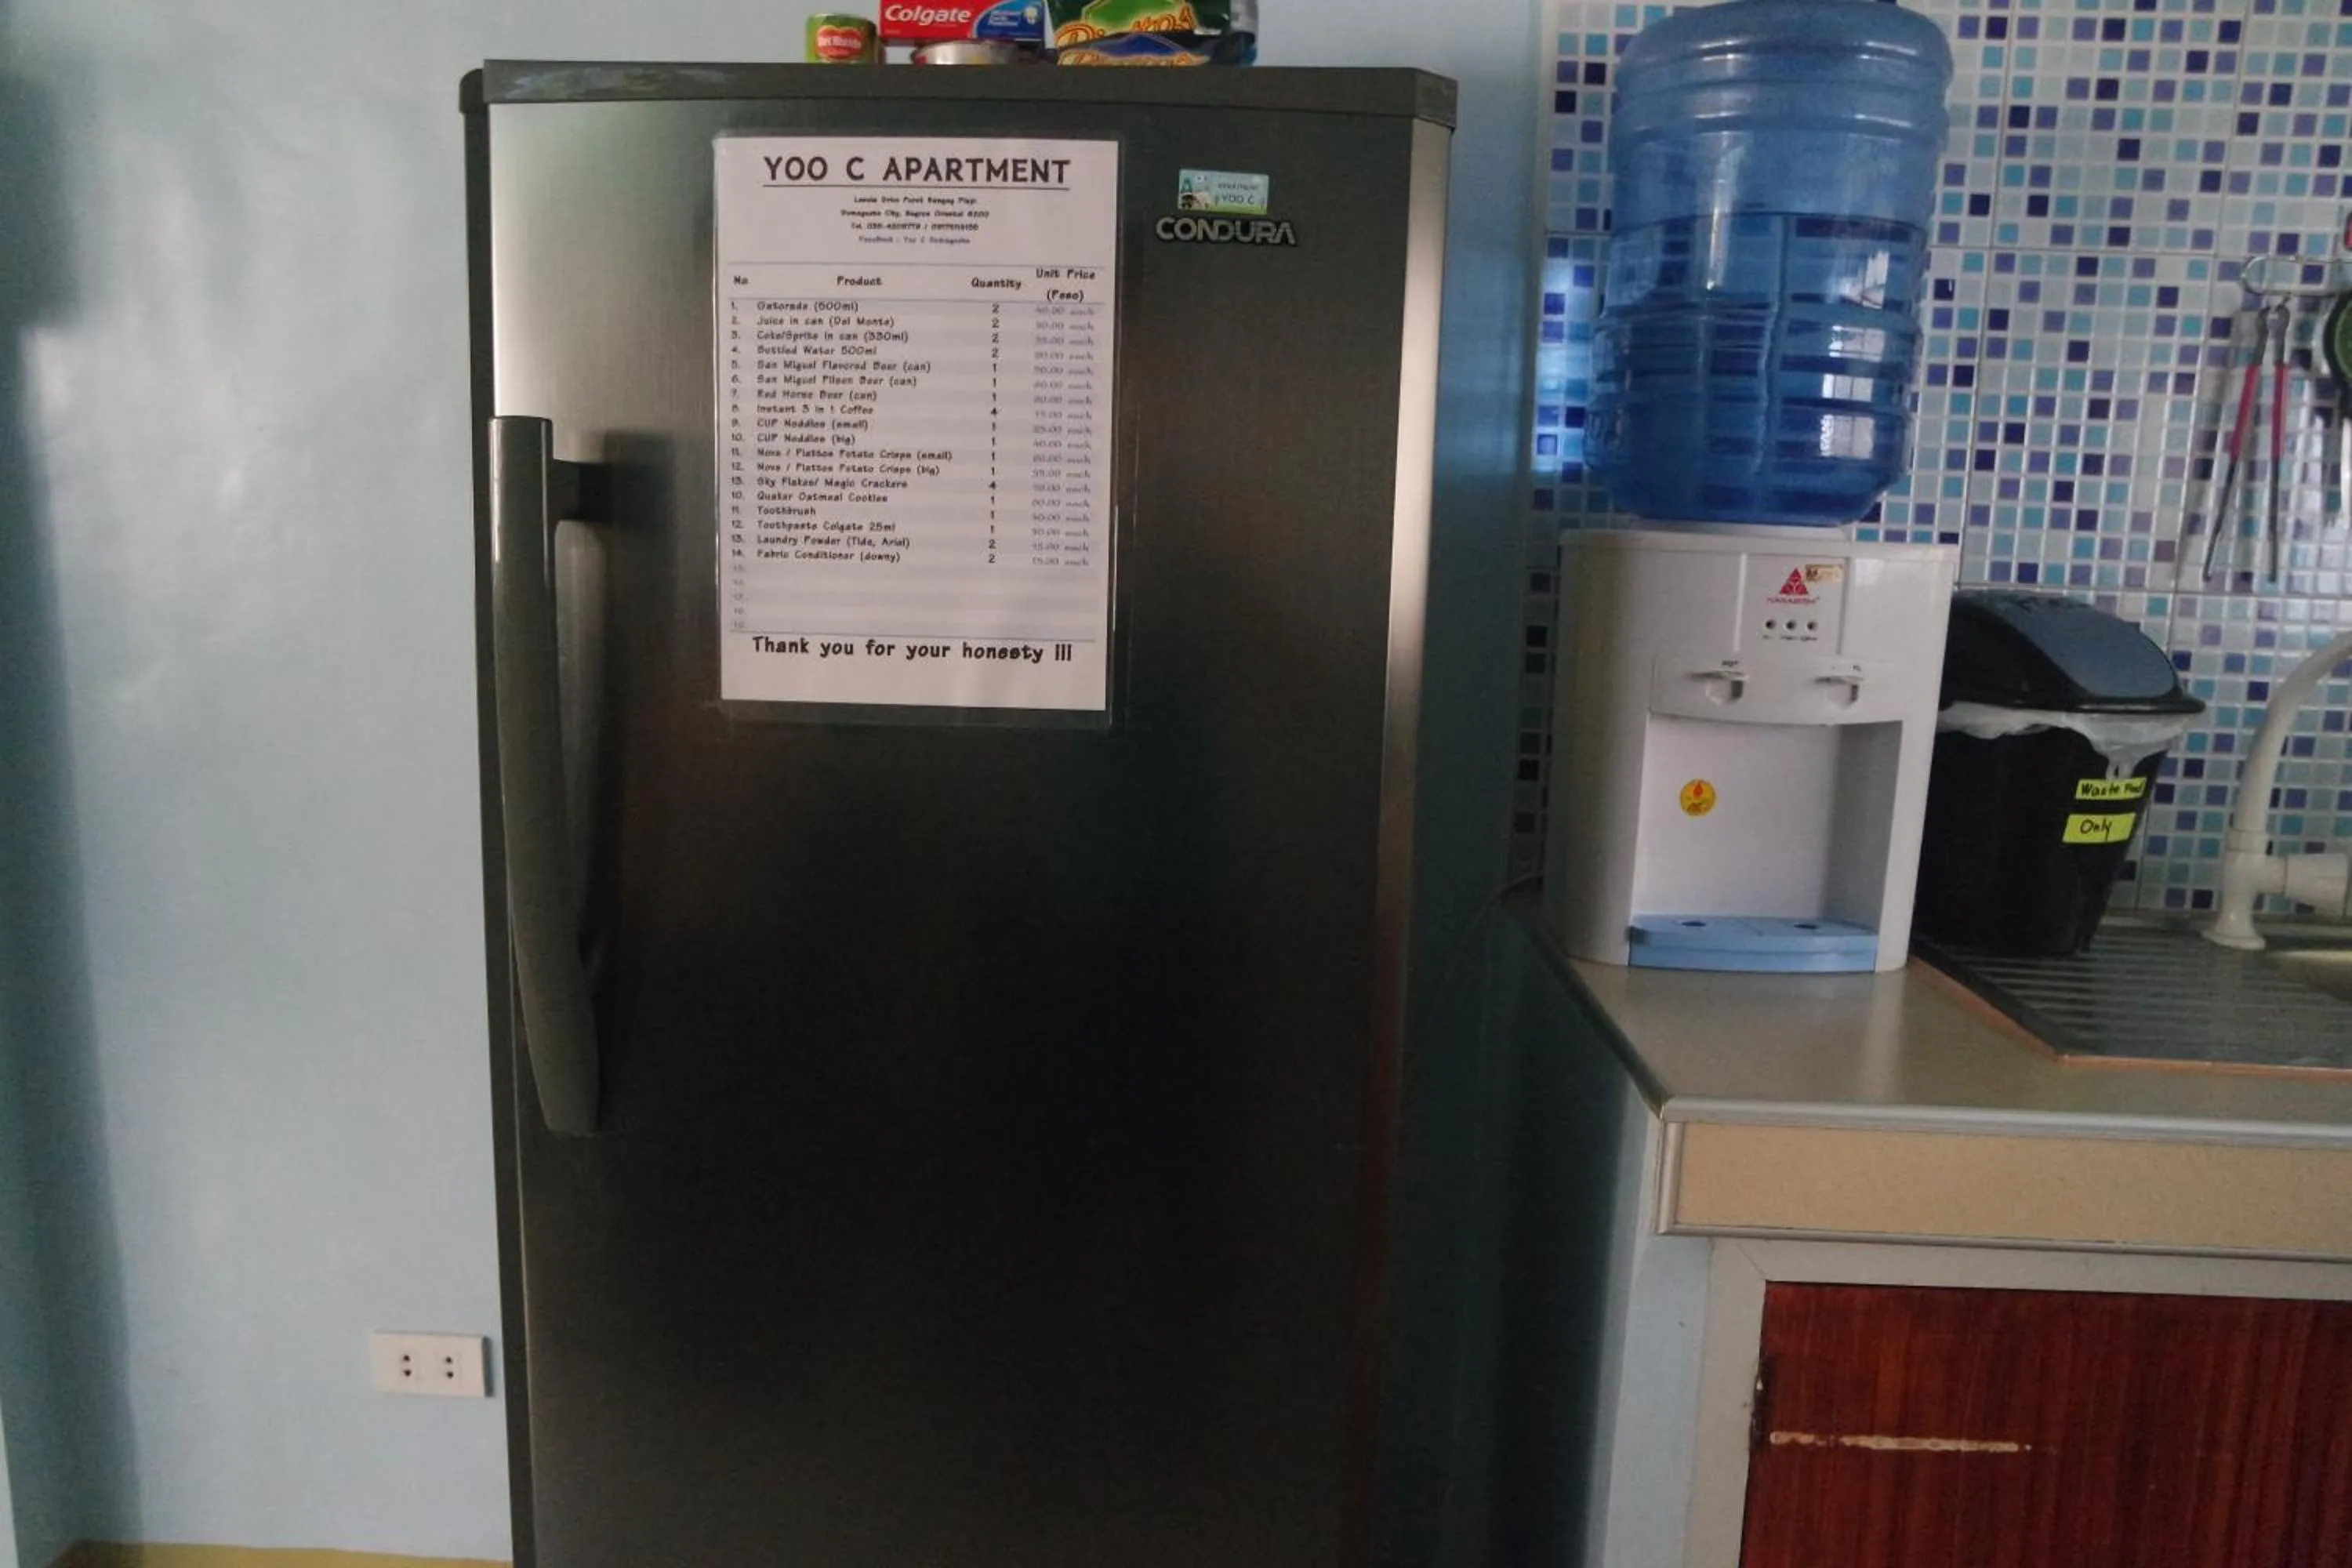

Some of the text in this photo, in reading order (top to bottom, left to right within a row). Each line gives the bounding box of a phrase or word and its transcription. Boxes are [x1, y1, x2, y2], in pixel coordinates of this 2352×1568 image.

[884, 5, 971, 26] Colgate
[764, 157, 1071, 184] YOO C APARTMENT
[1156, 216, 1296, 245] CONDURA
[1036, 268, 1096, 280] Unit Price
[837, 275, 882, 286] Product
[971, 278, 1022, 291] Quantity
[1047, 289, 1084, 303] (Peso)
[757, 301, 808, 311] Gatorade
[992, 303, 1000, 314] 2
[757, 316, 785, 326] Juice
[790, 316, 798, 325] in
[992, 318, 1000, 328] 2
[825, 331, 833, 340] in
[839, 332, 858, 341] can
[992, 332, 999, 343] 2
[803, 345, 835, 355] Water
[992, 347, 999, 359] 2
[757, 359, 778, 369] San
[783, 359, 817, 372] Miguel
[822, 360, 866, 371] Flavored
[757, 374, 778, 383] San
[784, 374, 816, 387] Miguel
[822, 375, 853, 385] Pilsen
[757, 389, 777, 398] Red
[782, 390, 814, 400] Horse
[757, 405, 797, 416] Instant
[840, 404, 873, 415] Coffee
[757, 418, 778, 428] CUP
[757, 433, 778, 443] CUP
[839, 449, 874, 459] Potato
[840, 463, 874, 474] Potato
[757, 477, 776, 488] Sky
[825, 477, 855, 490] Magic
[861, 478, 907, 488] Crackers
[757, 491, 793, 501] Quaker
[797, 492, 843, 502] Oatmeal
[848, 492, 887, 503] Cookies
[757, 505, 815, 516] Toothbrush
[757, 520, 818, 532] Toothpaste
[823, 521, 863, 533] Colgate
[757, 535, 798, 546] Laundry
[804, 535, 840, 546] Powder
[989, 539, 996, 550] 2
[757, 549, 789, 558] Fabric
[794, 550, 855, 560] Conditioner
[860, 551, 900, 563] (downy)
[989, 554, 995, 564] 2
[753, 636, 810, 655] Thank
[819, 643, 854, 658] you
[866, 640, 895, 657] for
[906, 644, 951, 660] your
[962, 643, 1044, 663] honesty
[2082, 783, 2120, 797] Waste
[2080, 817, 2112, 841] Only
